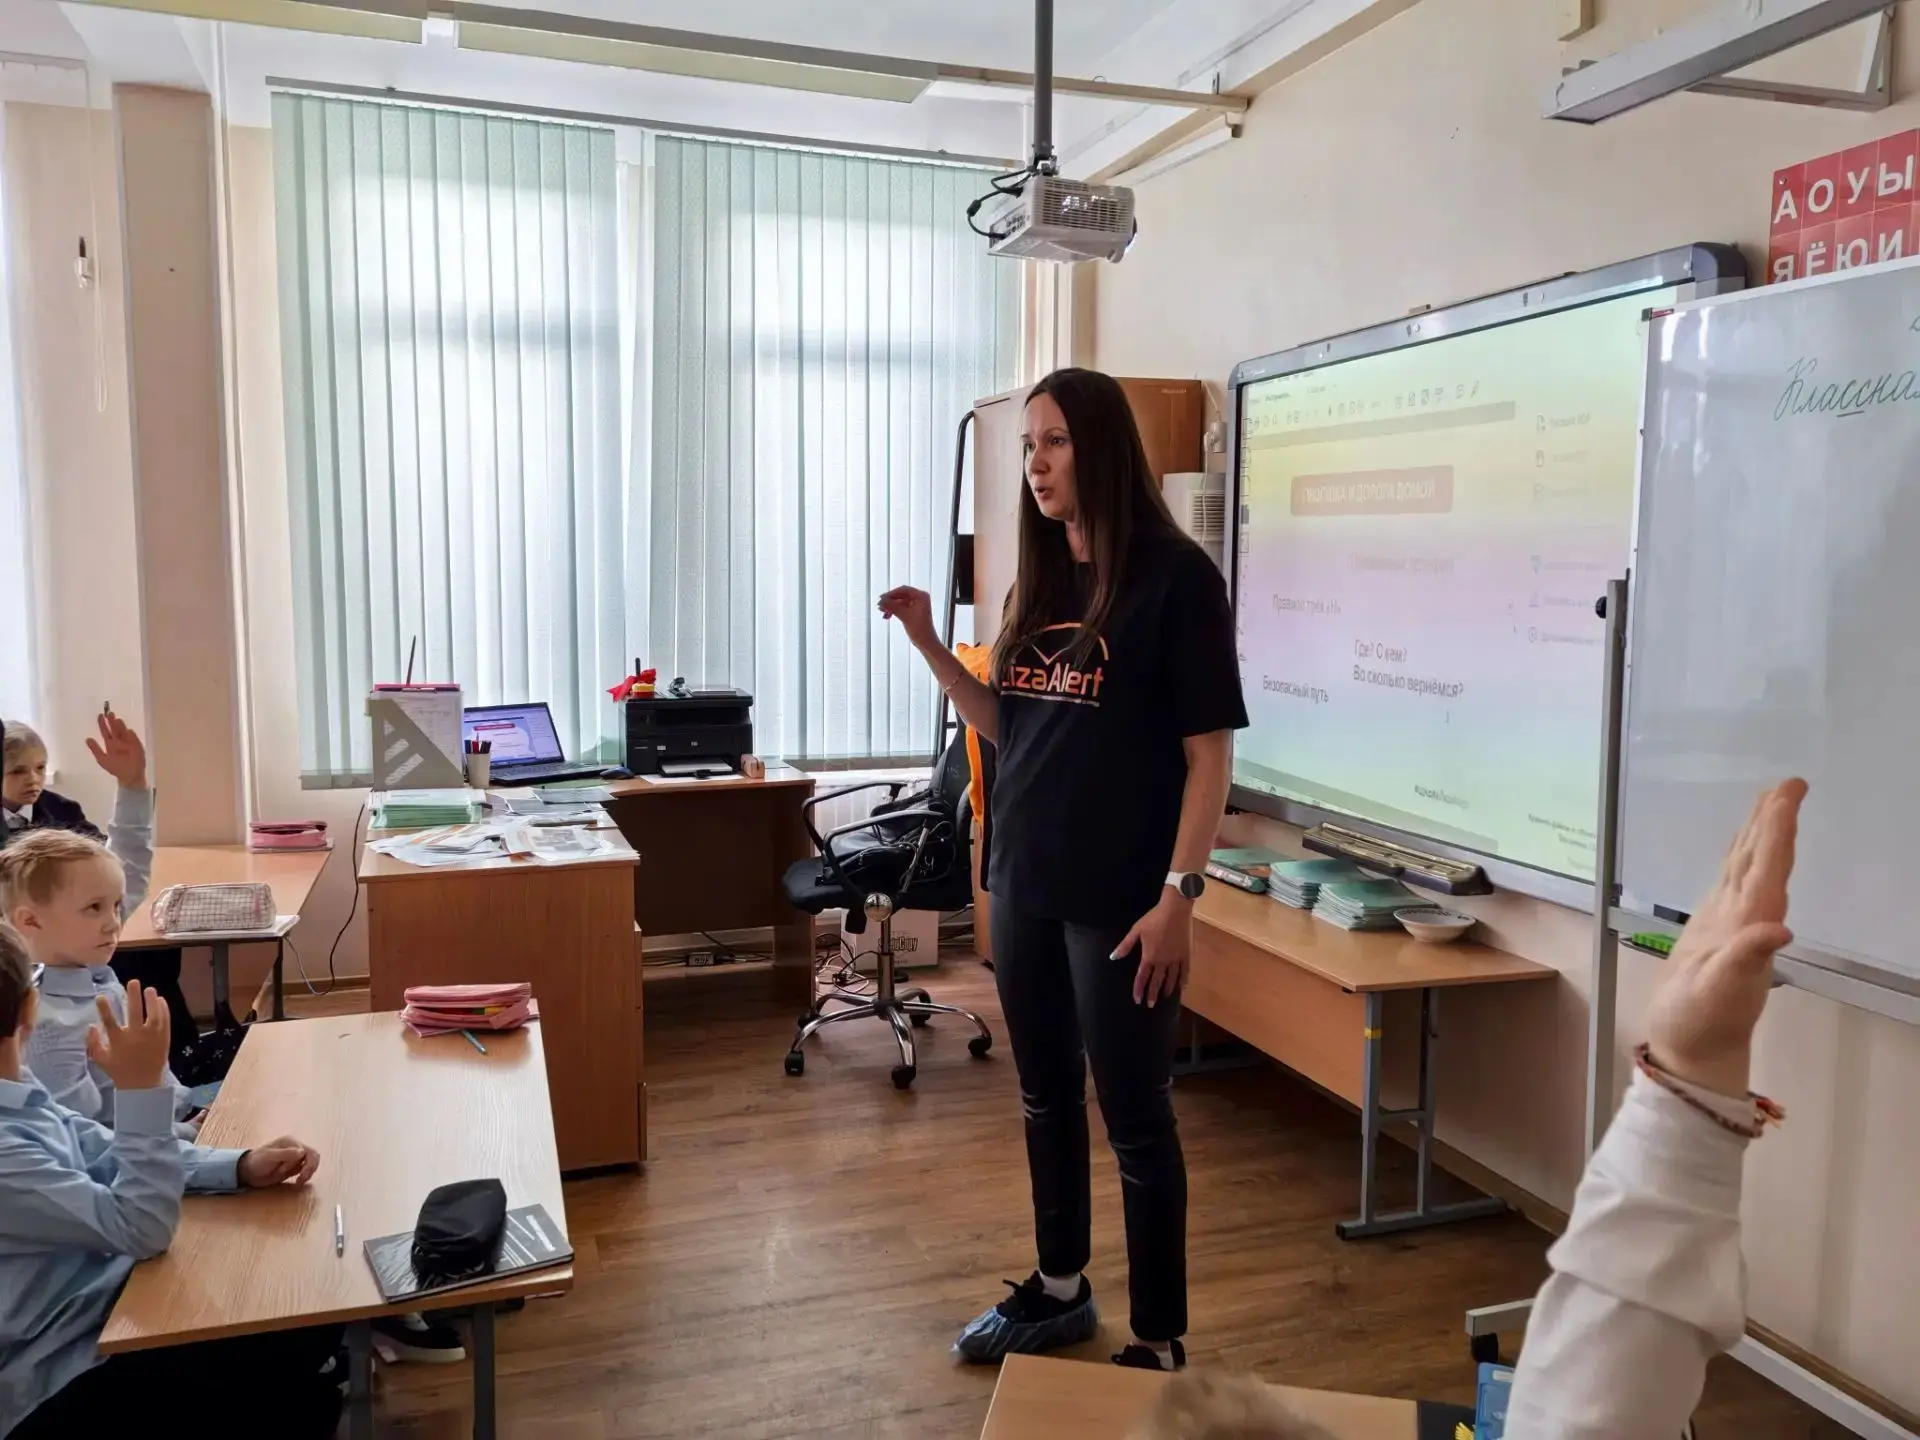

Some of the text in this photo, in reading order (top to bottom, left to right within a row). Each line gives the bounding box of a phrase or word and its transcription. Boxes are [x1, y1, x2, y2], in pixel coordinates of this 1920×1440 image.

[1774, 356, 1920, 421] Классна
[1263, 674, 1310, 699] Безопасный
[1367, 670, 1406, 690] сколько
